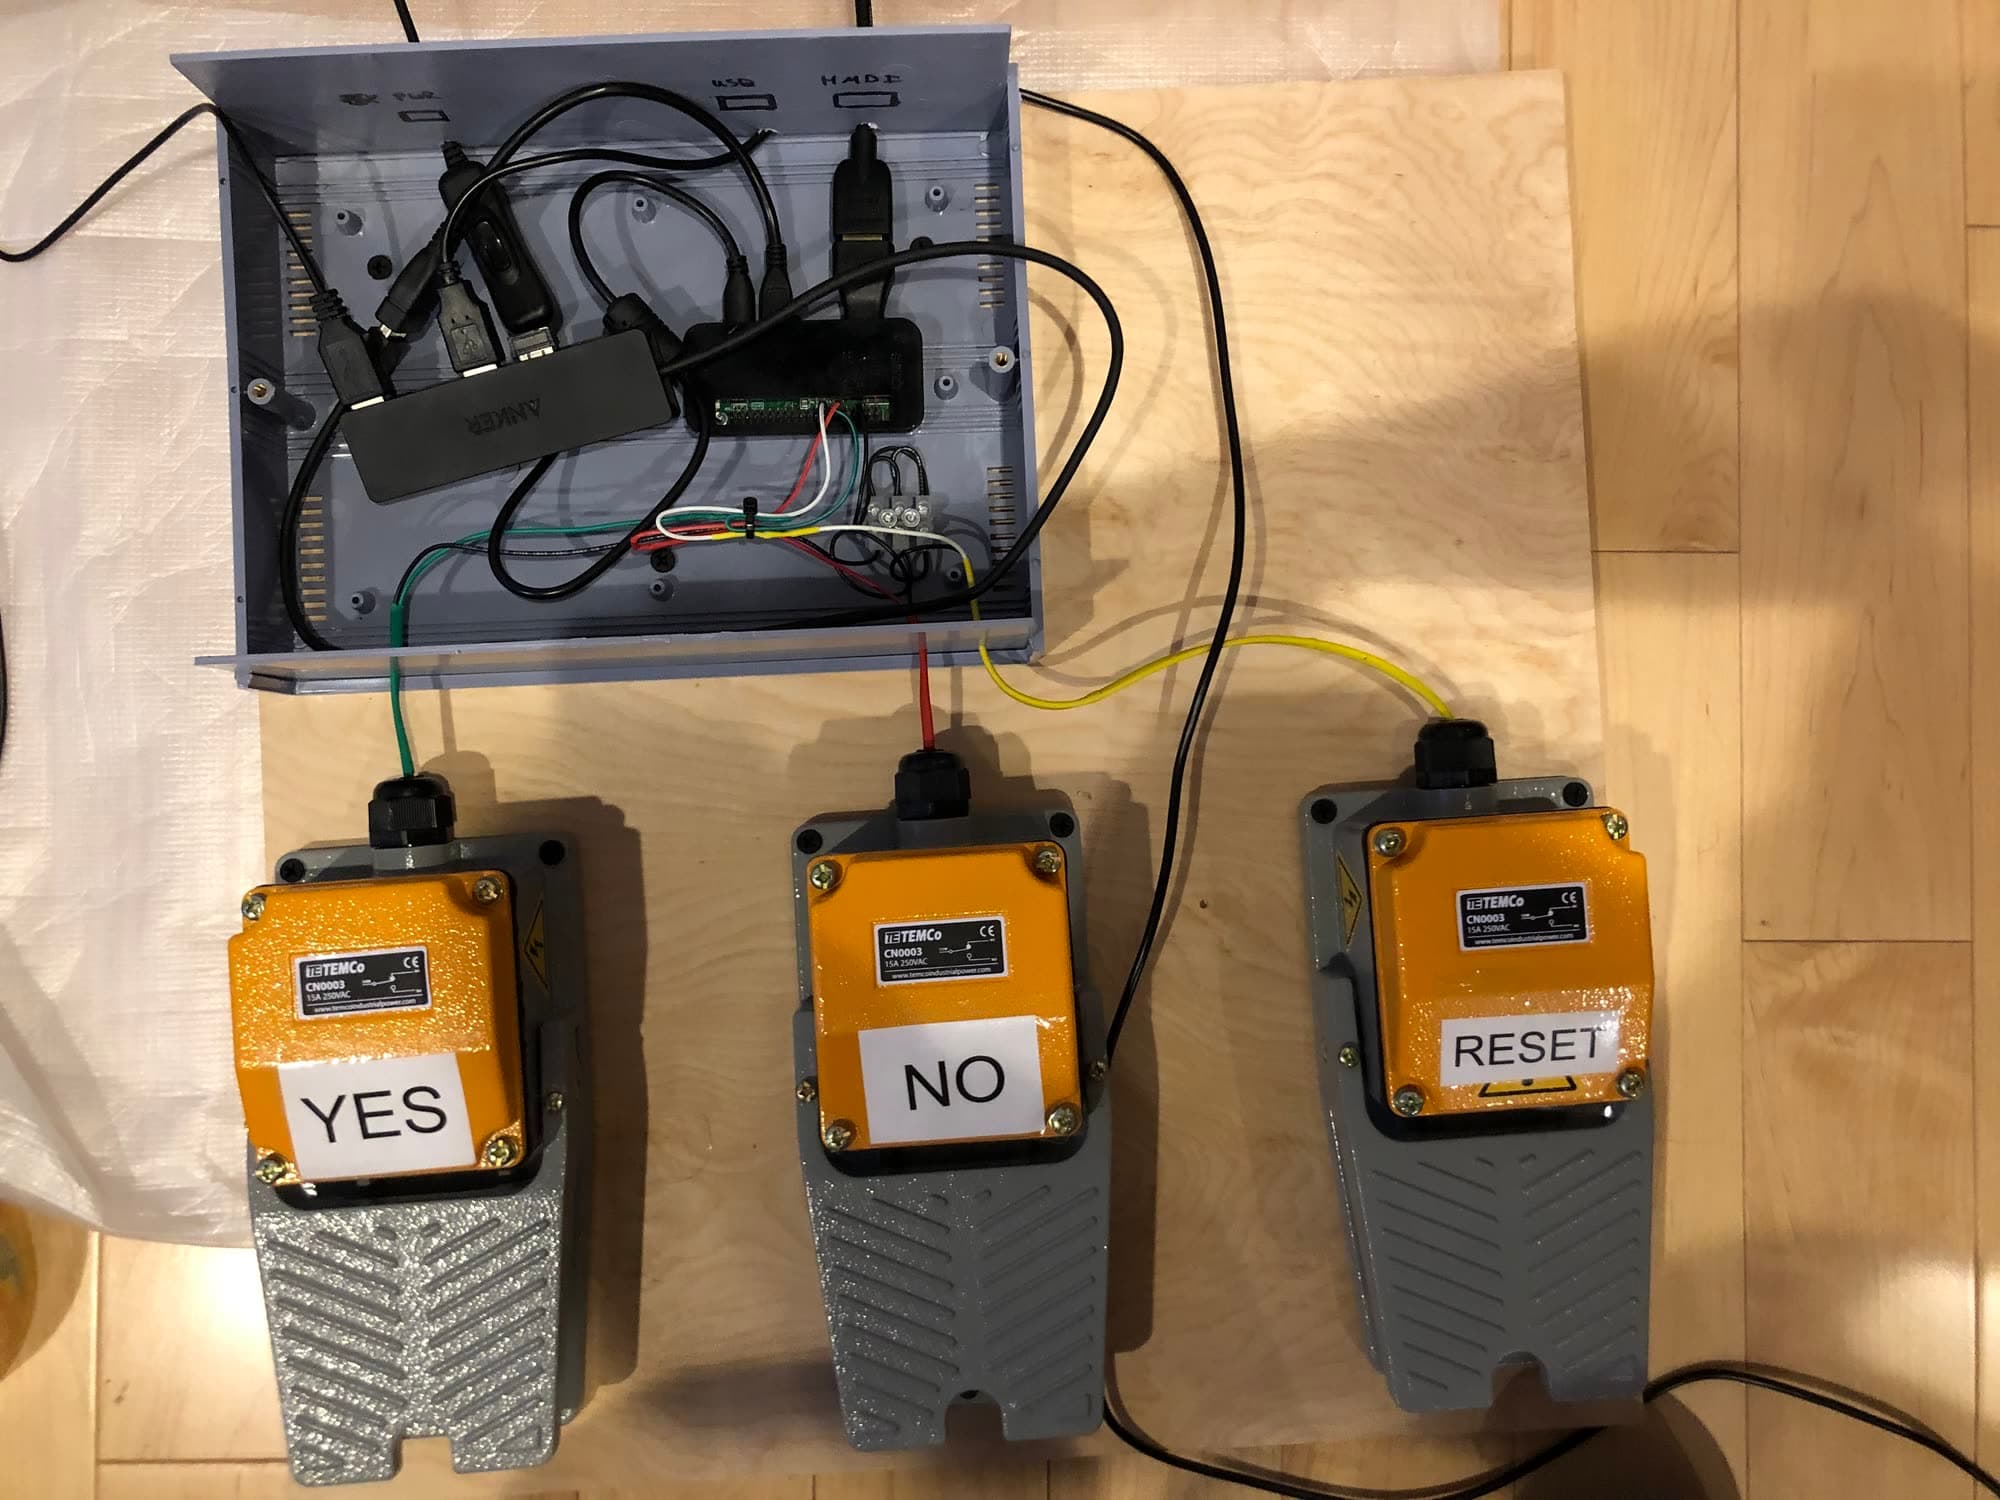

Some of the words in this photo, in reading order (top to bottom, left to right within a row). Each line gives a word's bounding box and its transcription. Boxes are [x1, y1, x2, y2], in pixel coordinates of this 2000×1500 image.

[821, 74, 902, 86] HMDI
[464, 398, 540, 436] ANKER
[1483, 895, 1525, 909] TEMCo
[1466, 913, 1505, 925] CN0003
[901, 928, 942, 943] TEMCo
[1467, 925, 1481, 934] 15A
[1483, 924, 1510, 933] 250VAC
[883, 947, 923, 959] CN0003
[323, 961, 366, 976] TEMCo
[885, 959, 899, 968] 15A
[901, 957, 928, 967] 250VAC
[305, 980, 345, 992] CN0003
[306, 992, 321, 1002] 15A
[323, 990, 351, 1001] 250VAC
[1454, 1026, 1607, 1067] RESET
[904, 1055, 1005, 1110] NO
[300, 1086, 447, 1143] YES
